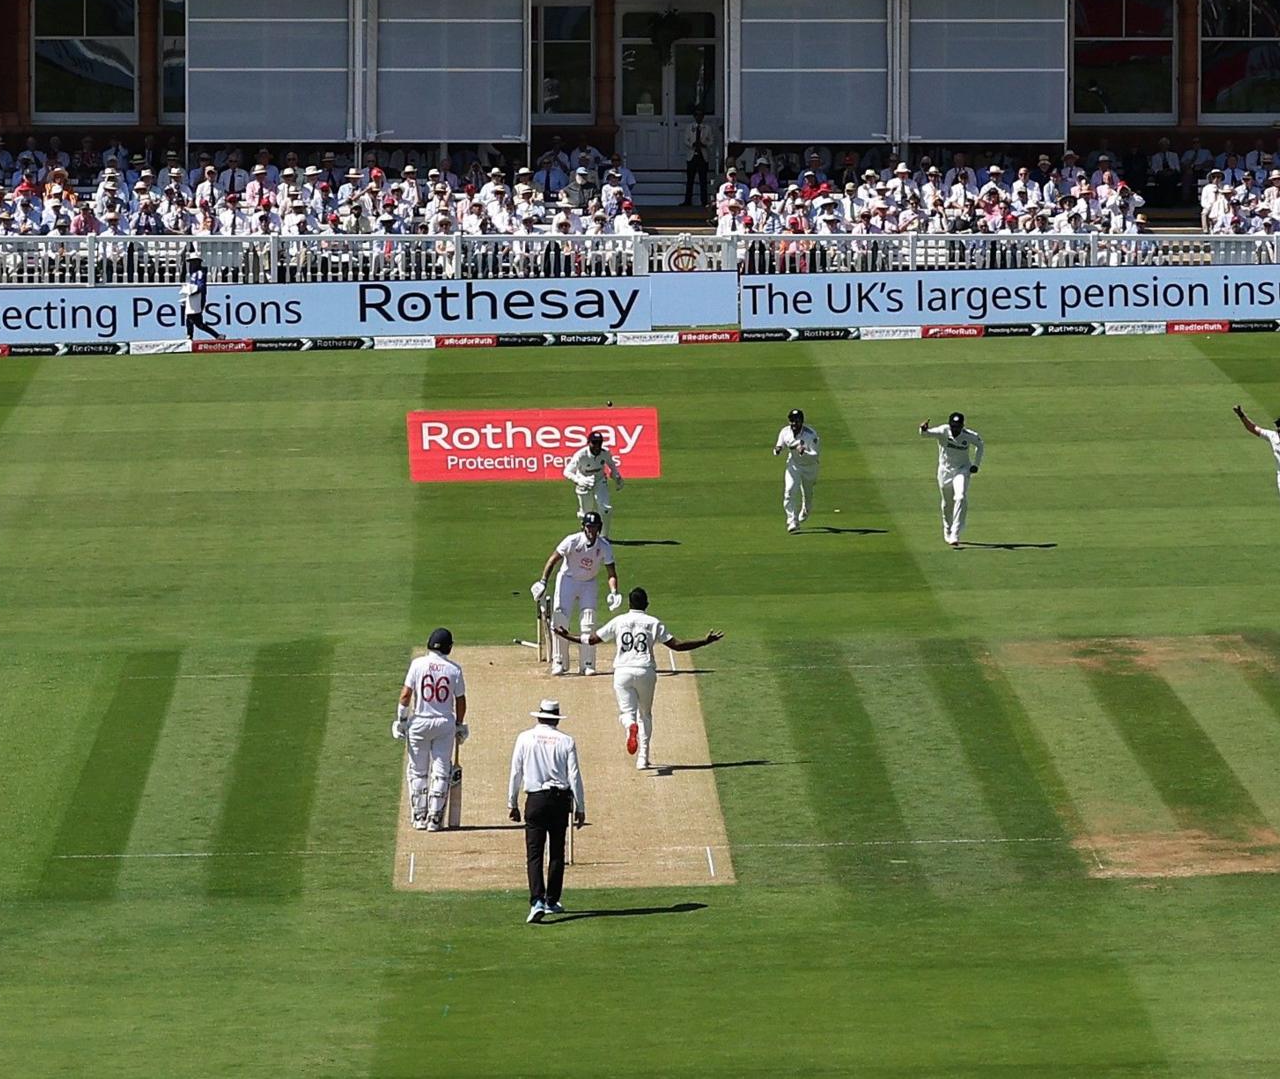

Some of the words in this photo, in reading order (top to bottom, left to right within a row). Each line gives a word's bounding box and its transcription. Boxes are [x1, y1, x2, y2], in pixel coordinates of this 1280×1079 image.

[359, 283, 640, 329] Rothesay
[743, 283, 812, 314] The
[918, 280, 1047, 319] largest
[1061, 276, 1209, 317] pension
[421, 421, 644, 454] Rothesay
[447, 454, 538, 472] Protecting
[543, 453, 621, 468] Pens
[621, 631, 647, 653] 93
[421, 674, 450, 704] 66
